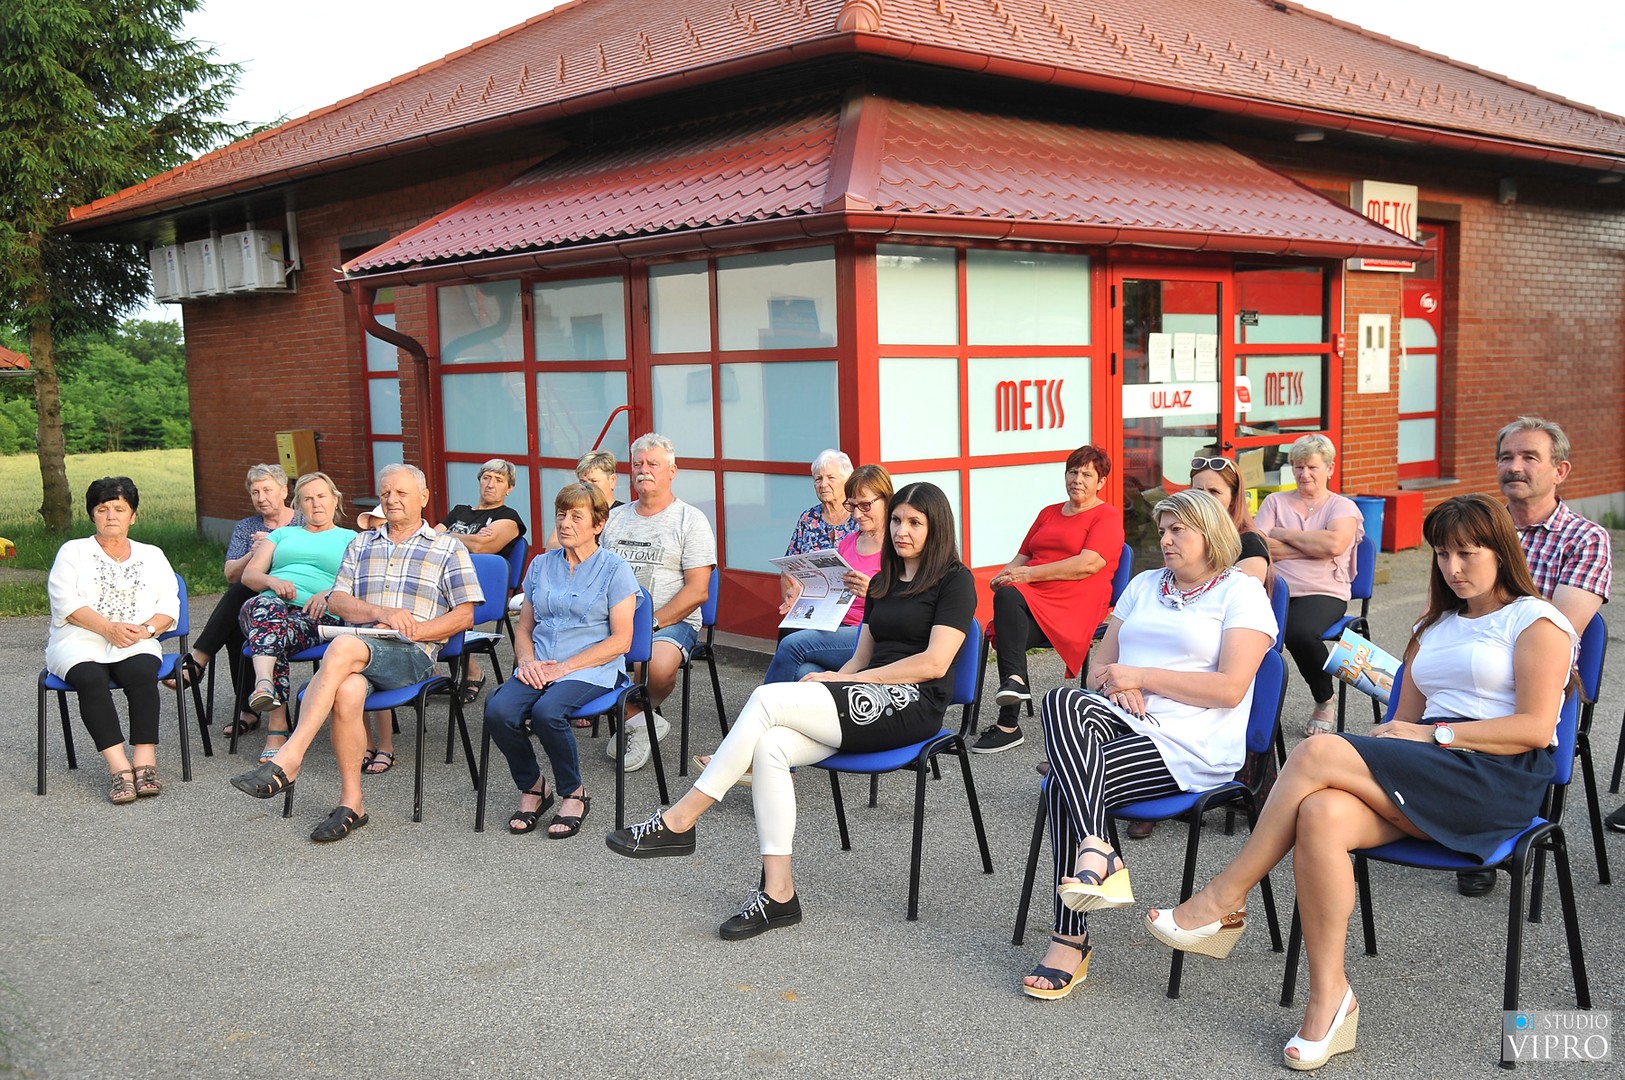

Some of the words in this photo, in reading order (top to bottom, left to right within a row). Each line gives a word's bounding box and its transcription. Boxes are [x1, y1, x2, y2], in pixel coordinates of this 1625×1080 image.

[996, 379, 1064, 432] METSS
[1151, 390, 1192, 409] ULAZ
[1265, 371, 1303, 406] METSS
